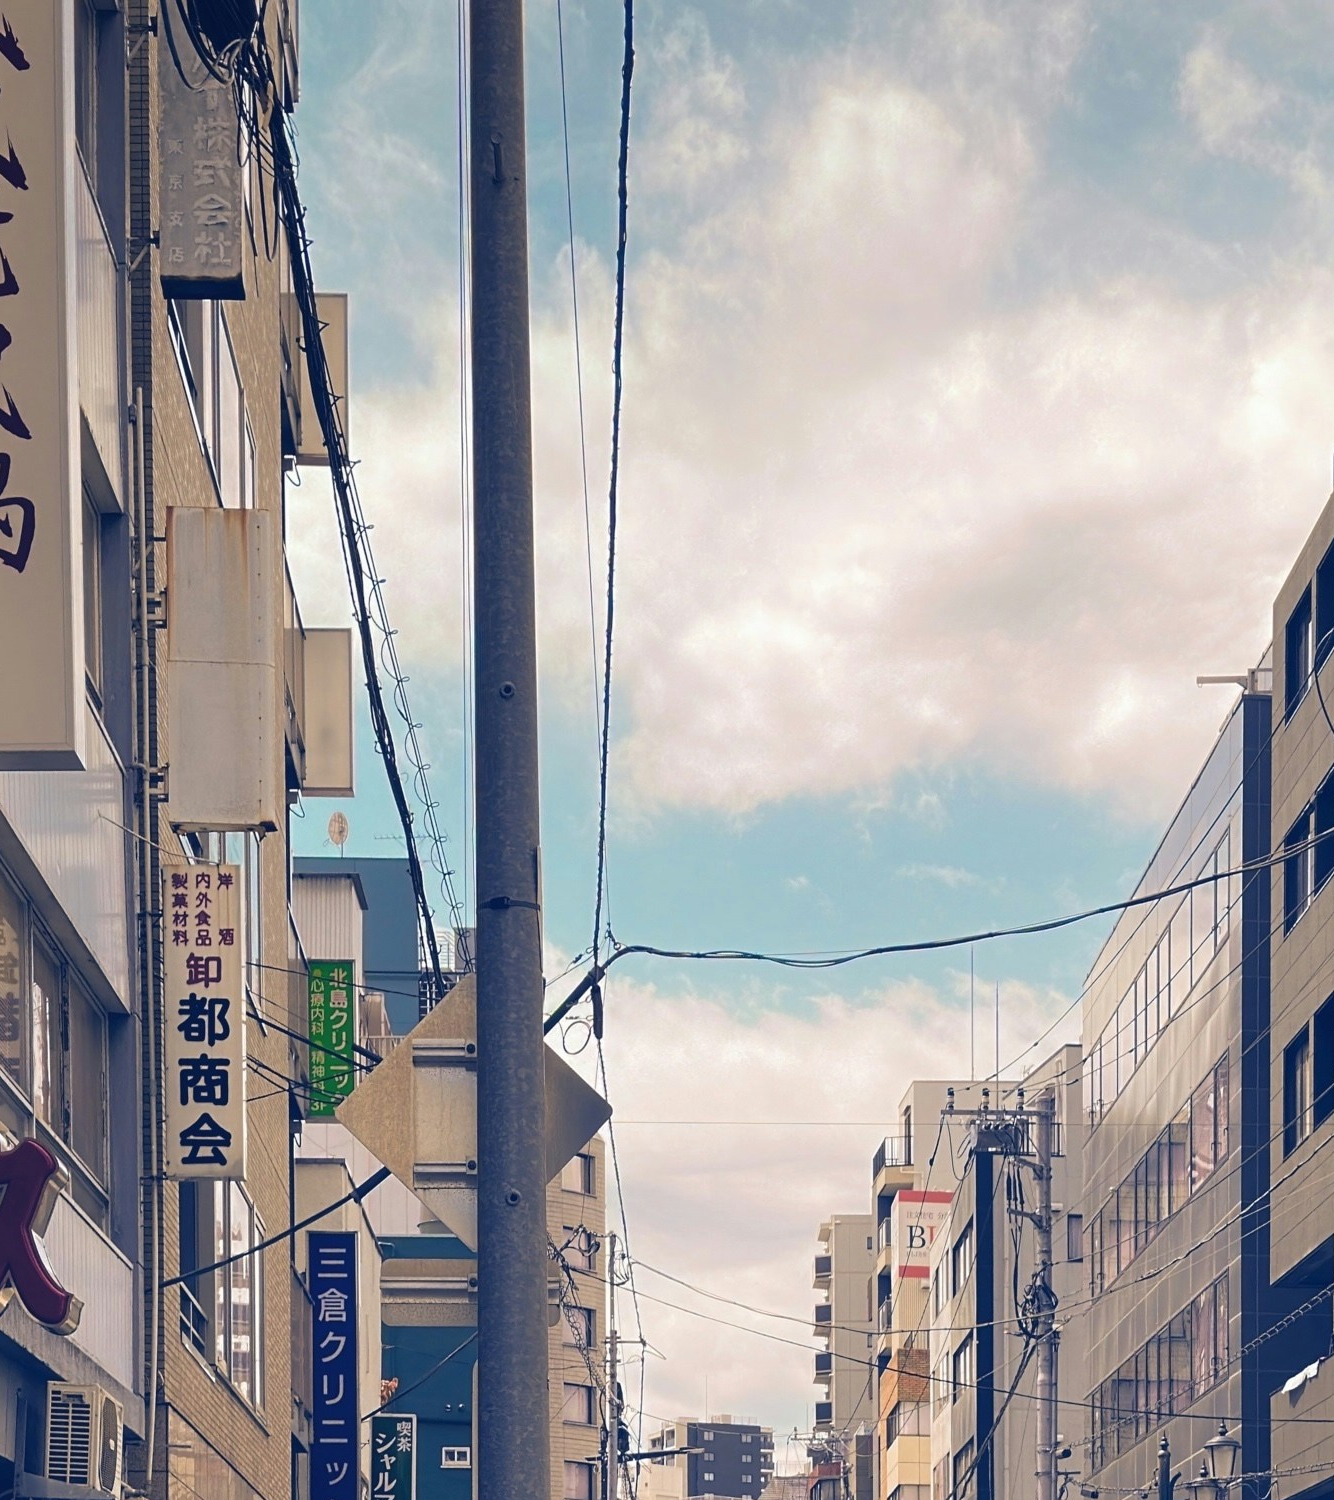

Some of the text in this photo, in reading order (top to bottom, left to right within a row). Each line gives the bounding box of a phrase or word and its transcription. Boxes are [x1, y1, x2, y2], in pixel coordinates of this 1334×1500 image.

[171, 872, 189, 947] 製菓材料
[194, 872, 212, 947] 内外食品
[217, 873, 235, 946] 洋酒
[186, 953, 222, 989] 卸
[177, 992, 232, 1166] 都商会
[396, 1420, 412, 1453] 喫茶
